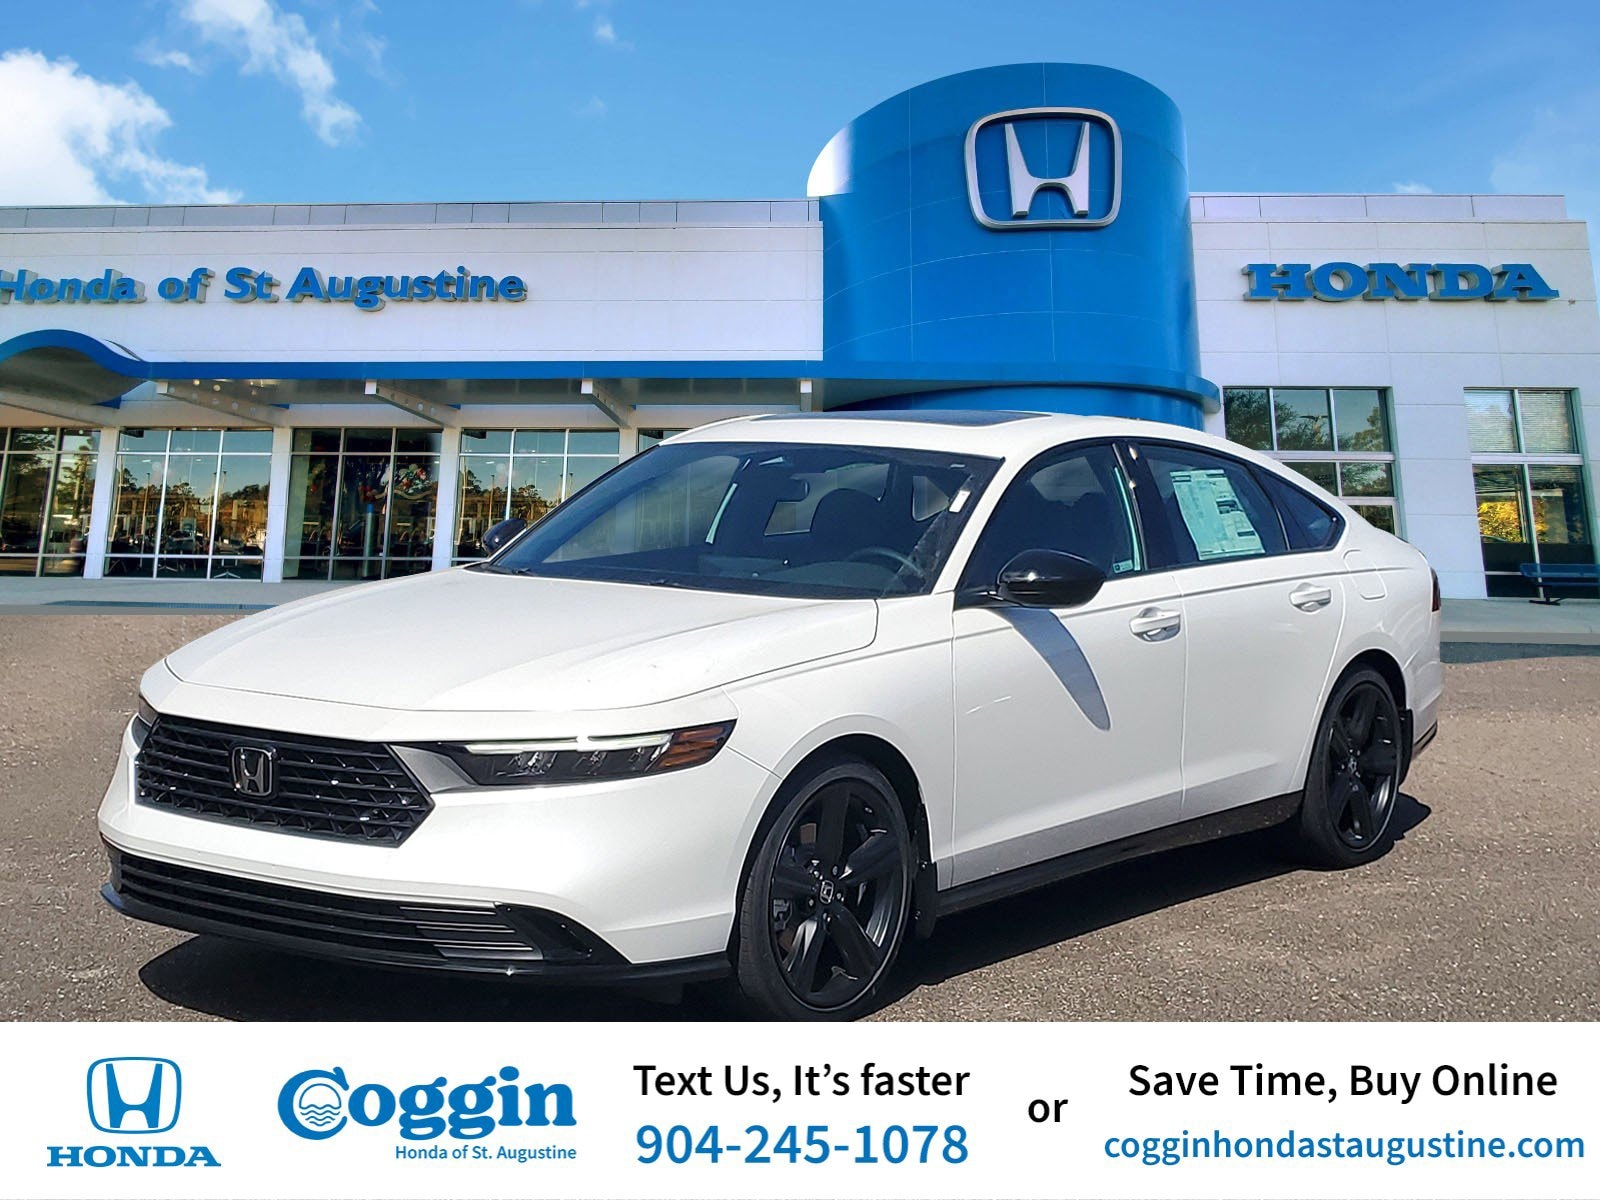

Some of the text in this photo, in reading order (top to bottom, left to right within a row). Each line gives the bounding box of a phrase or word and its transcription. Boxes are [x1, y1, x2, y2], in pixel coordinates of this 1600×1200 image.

[0, 266, 526, 310] Honda of St Augustine
[1243, 262, 1559, 301] HONDA
